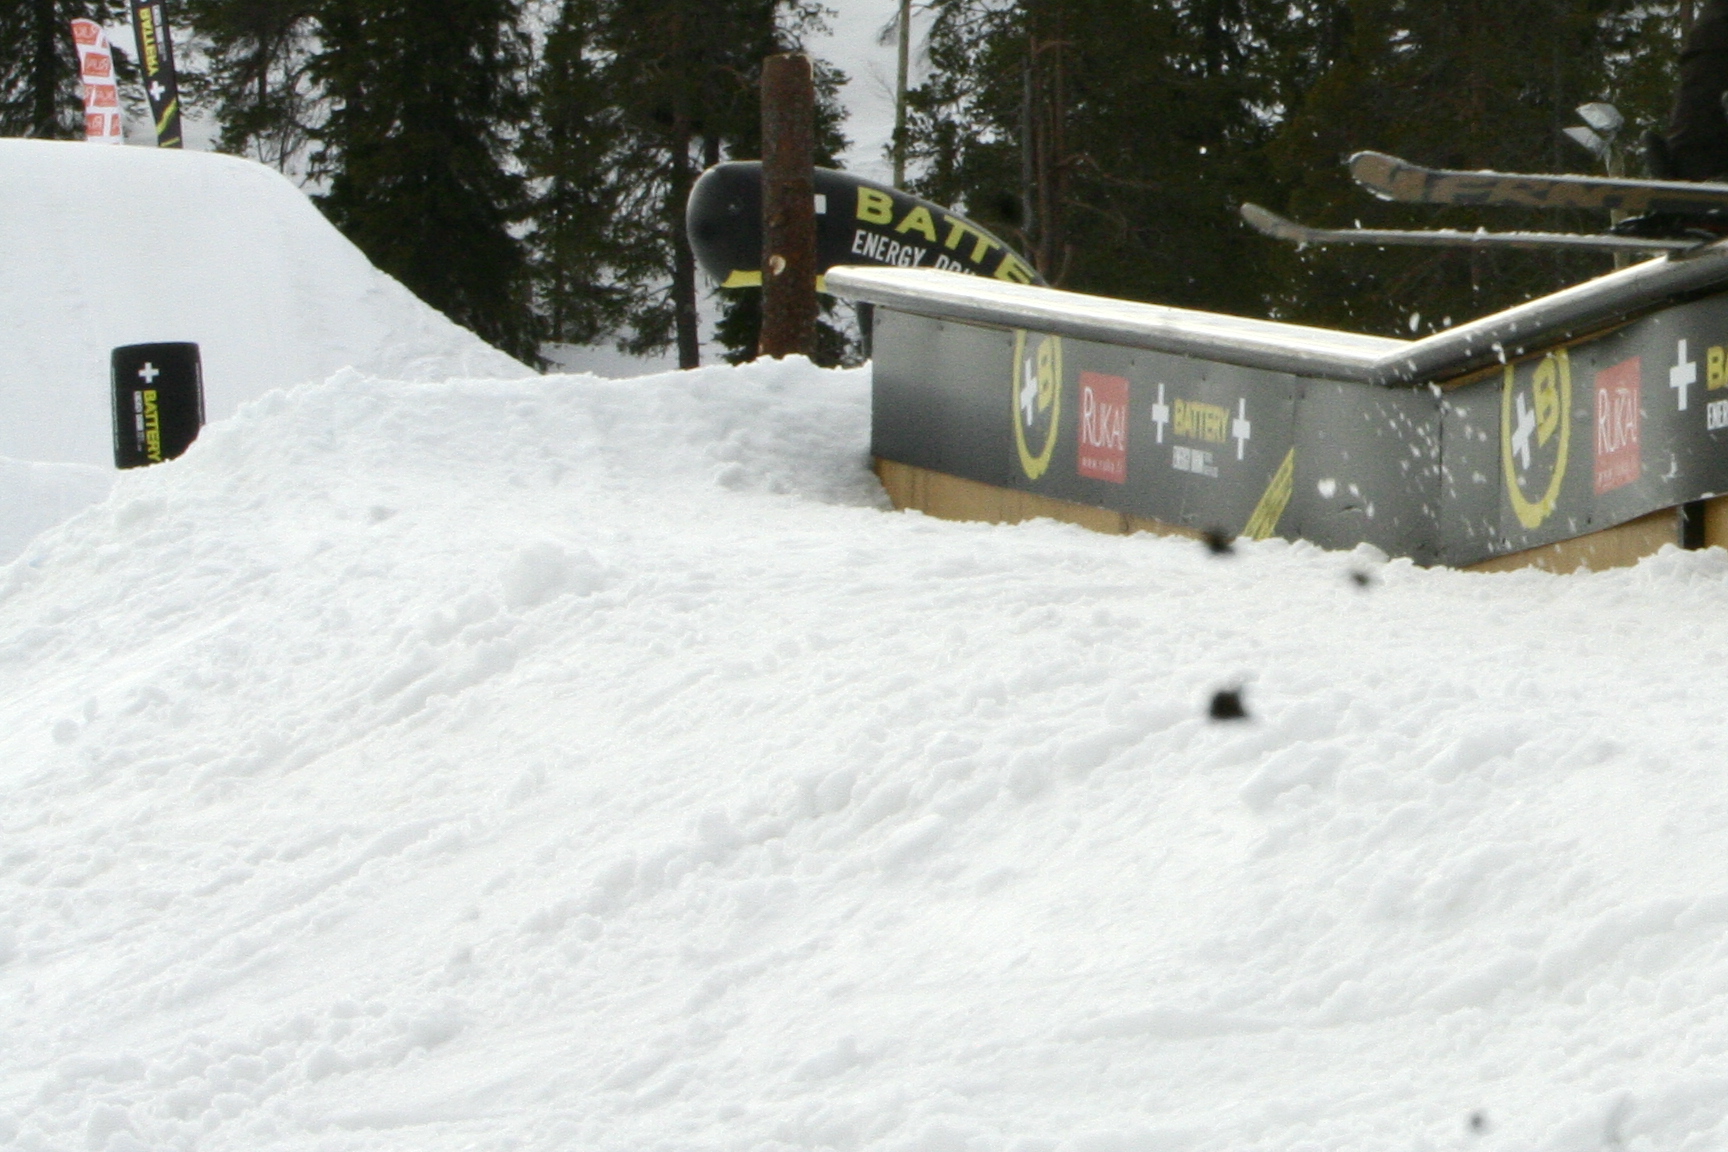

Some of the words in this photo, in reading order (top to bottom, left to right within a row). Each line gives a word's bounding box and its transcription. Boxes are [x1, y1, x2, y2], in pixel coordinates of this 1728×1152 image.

[852, 229, 926, 267] ENERGY
[144, 390, 162, 462] BATTERY
[1173, 398, 1230, 444] BATTERY
